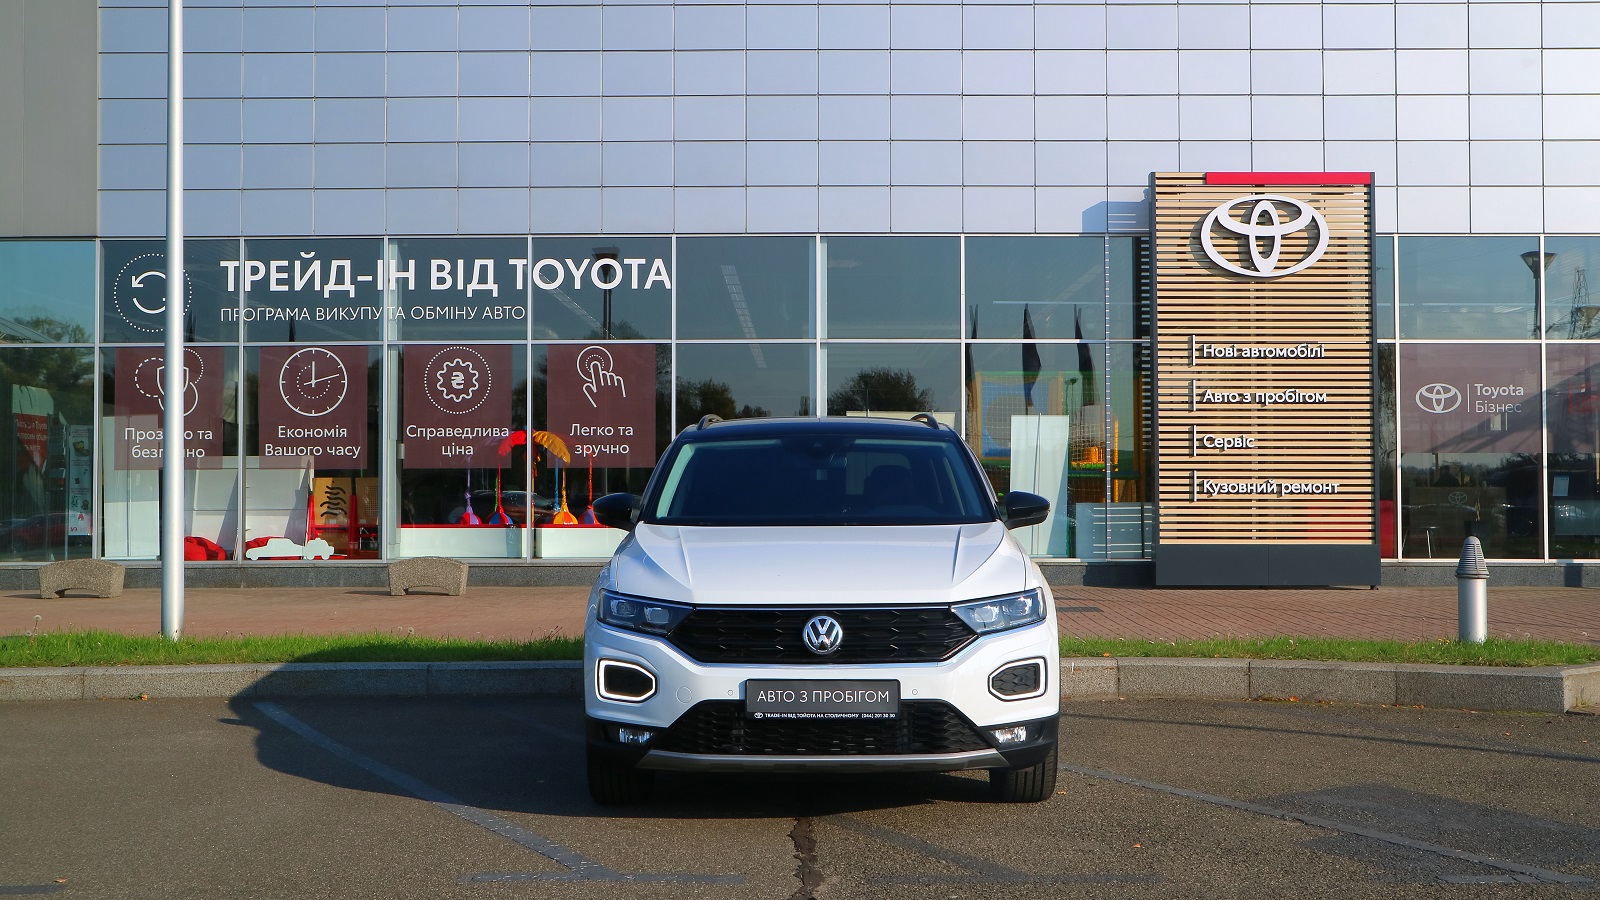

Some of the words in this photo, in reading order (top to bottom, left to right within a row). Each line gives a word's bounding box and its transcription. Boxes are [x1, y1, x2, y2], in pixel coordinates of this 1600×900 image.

[219, 251, 415, 298] ТРЕЙД-ІН
[430, 258, 499, 298] ВІД
[508, 257, 672, 290] TOYOTA
[220, 306, 310, 322] ПРОГРАМА
[316, 306, 383, 321] ВИКУПУ
[388, 305, 406, 320] ТА
[411, 305, 478, 321] ОБМІНУ
[482, 305, 526, 320] АВТО
[1202, 343, 1237, 358] Нові
[1241, 343, 1326, 358] автомобілі
[1203, 389, 1238, 402] Авто
[1242, 393, 1251, 402] з
[1255, 389, 1327, 405] пробігом
[1474, 383, 1525, 399] Toyota
[1475, 400, 1522, 413] Бізнес
[124, 427, 194, 443] Прозо
[197, 430, 213, 441] та
[278, 425, 347, 438] Економія
[406, 424, 510, 438] Справедлива
[569, 423, 614, 436] Легко
[618, 426, 634, 436] та
[441, 443, 474, 457] ціна
[574, 443, 630, 457] зручно
[1203, 434, 1255, 451] Сервіс
[264, 443, 323, 456] Вашого
[326, 445, 361, 458] часу
[1202, 479, 1277, 496] Кузовний
[1281, 484, 1341, 496] ремонт
[757, 690, 796, 703] АВТО
[812, 689, 890, 703] ПРОБІГОМ
